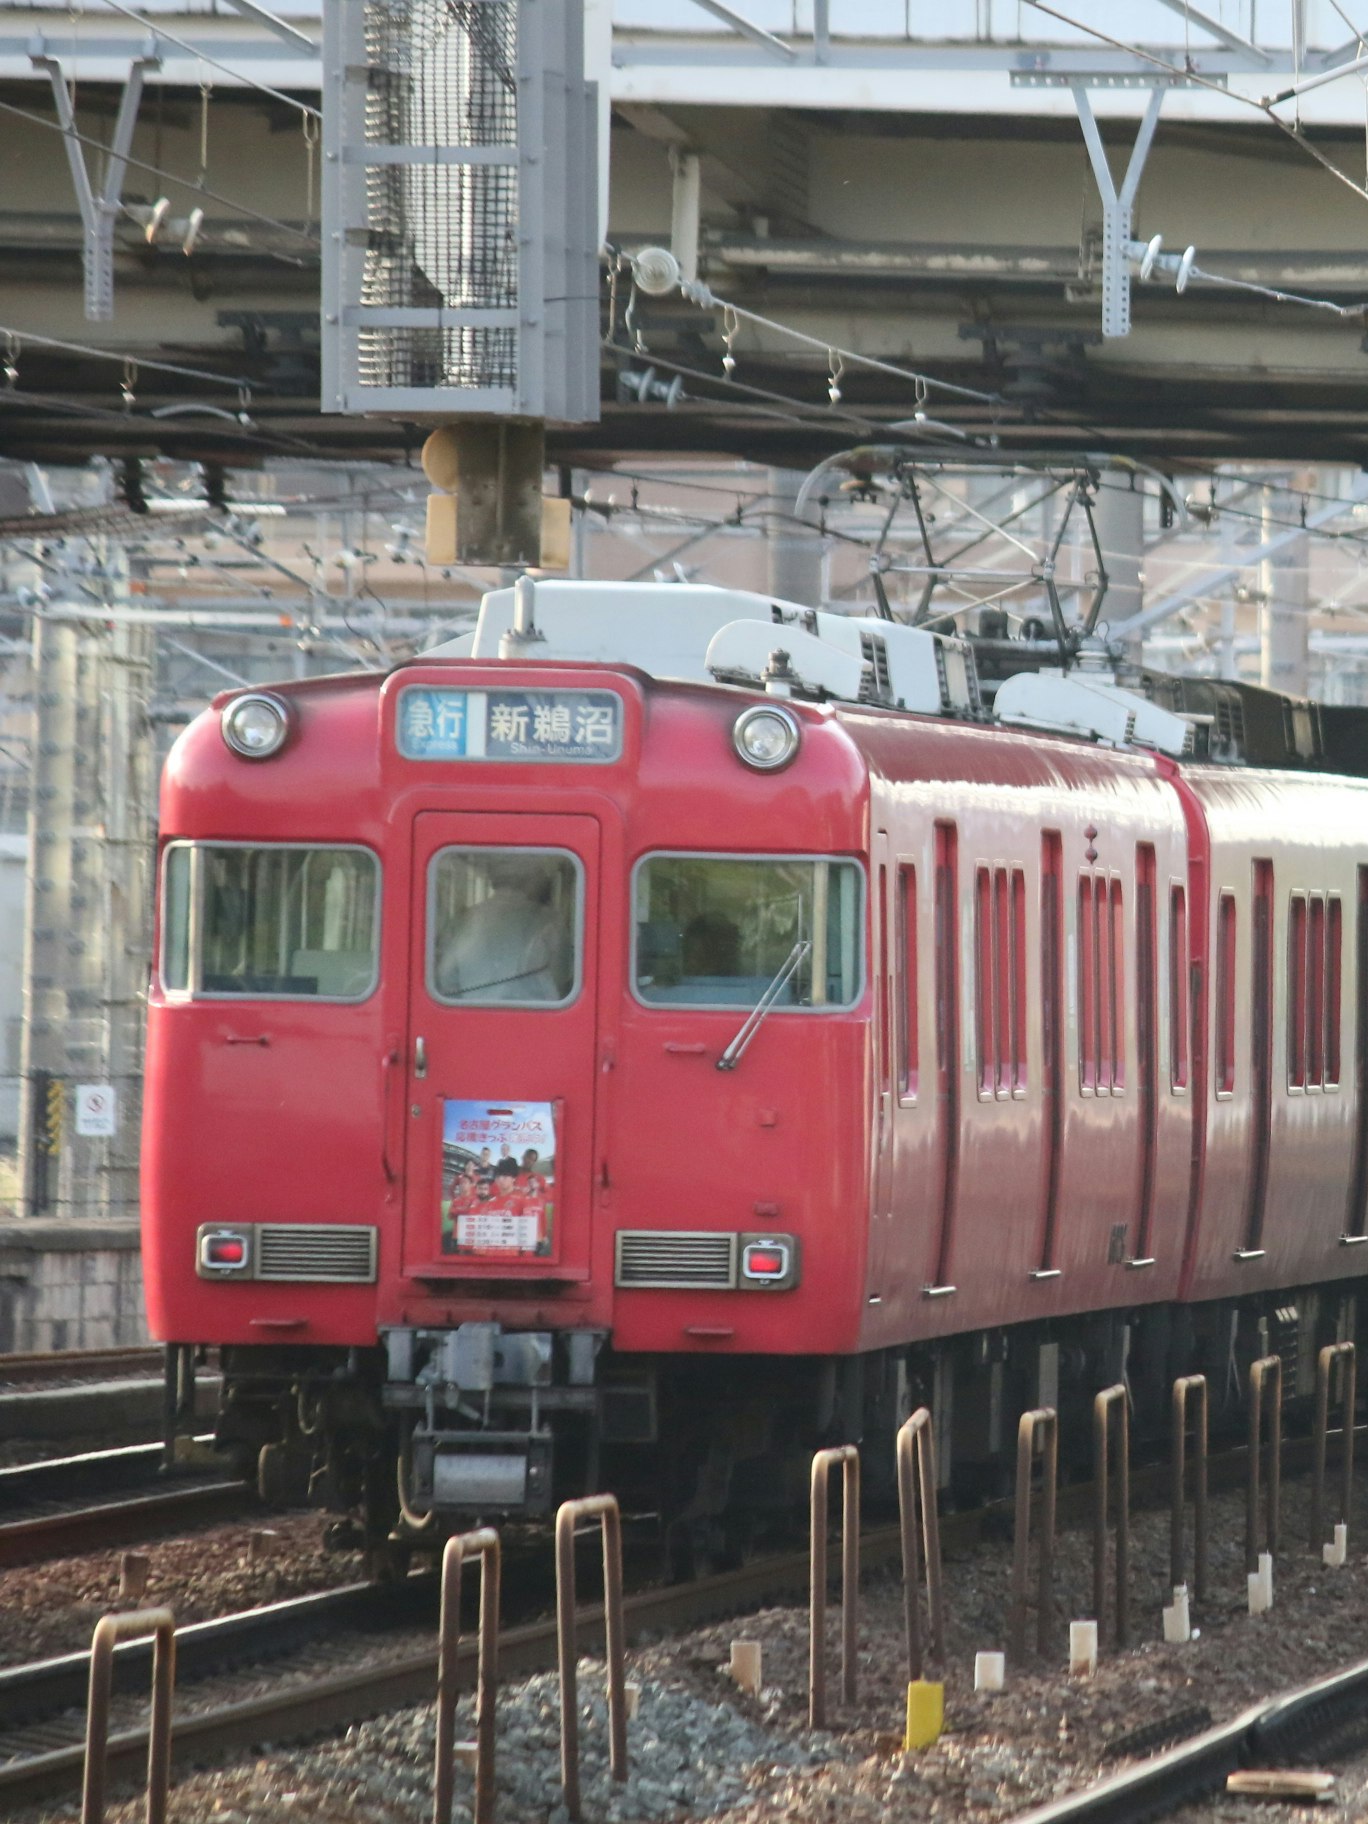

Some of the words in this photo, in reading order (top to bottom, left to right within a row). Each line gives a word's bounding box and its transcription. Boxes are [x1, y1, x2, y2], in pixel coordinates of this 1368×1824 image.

[407, 700, 464, 738] 急行
[491, 704, 613, 744] 新鵜沼
[510, 742, 593, 755] Shin-Unuma
